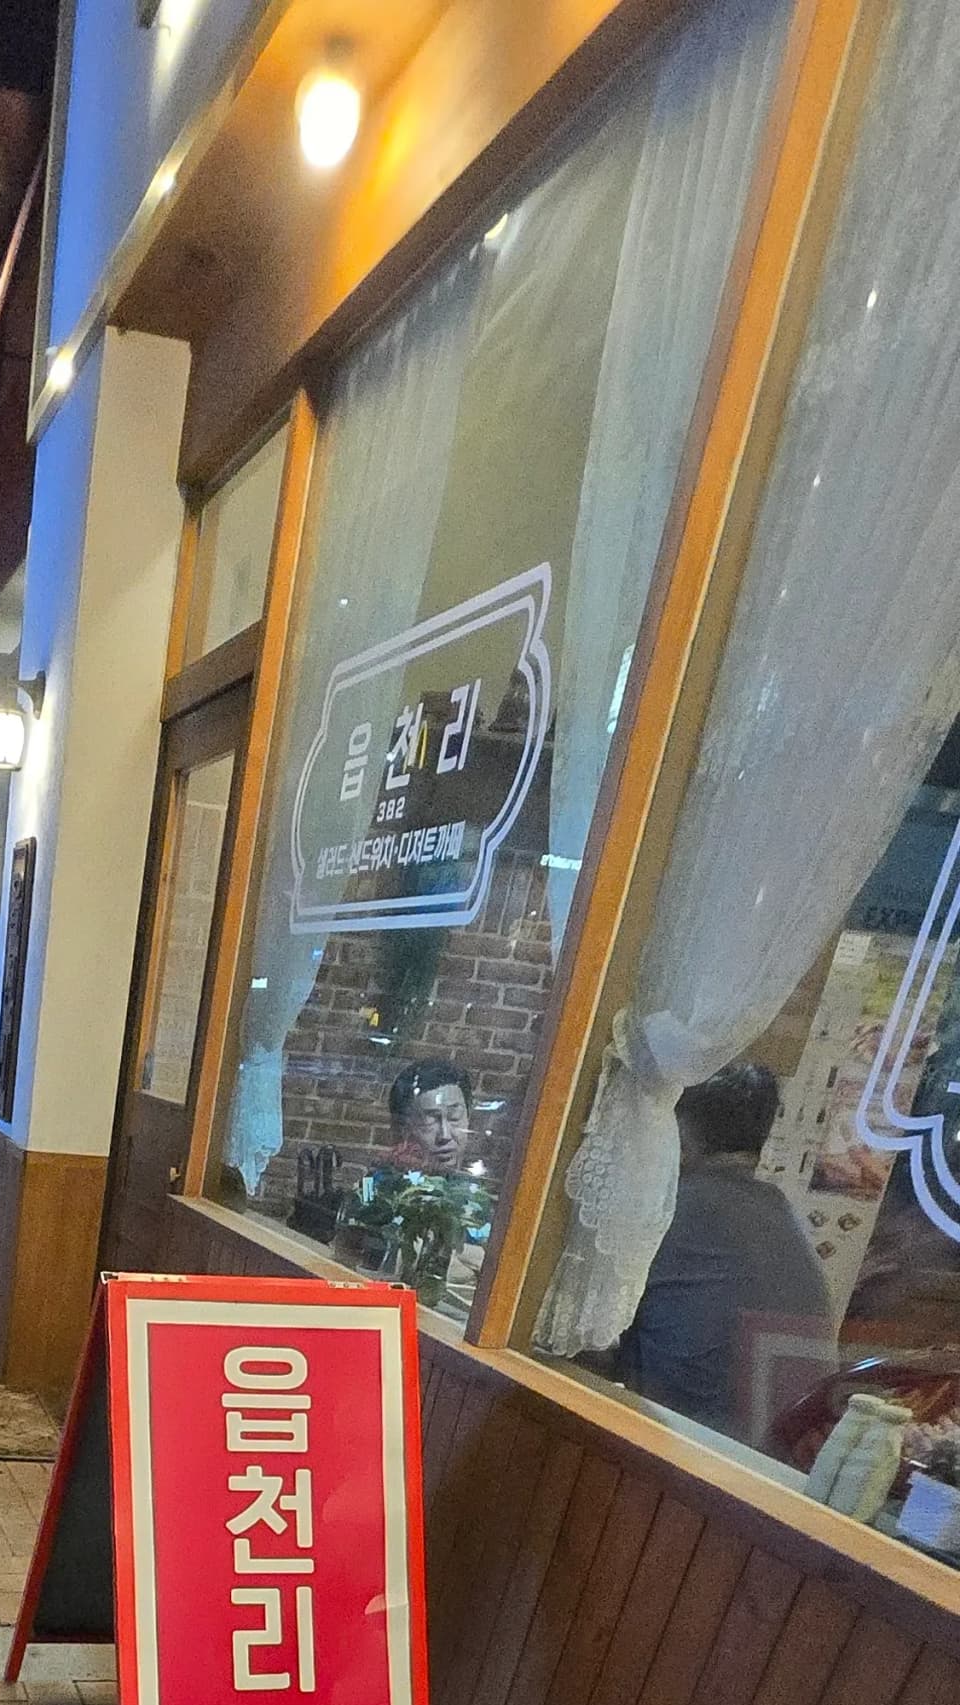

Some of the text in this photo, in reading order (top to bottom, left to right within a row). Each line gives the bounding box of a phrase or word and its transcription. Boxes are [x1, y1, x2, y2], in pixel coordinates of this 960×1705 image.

[340, 678, 481, 801] 읍천리
[377, 796, 406, 822] 382
[221, 1345, 316, 1694] 읍천리
